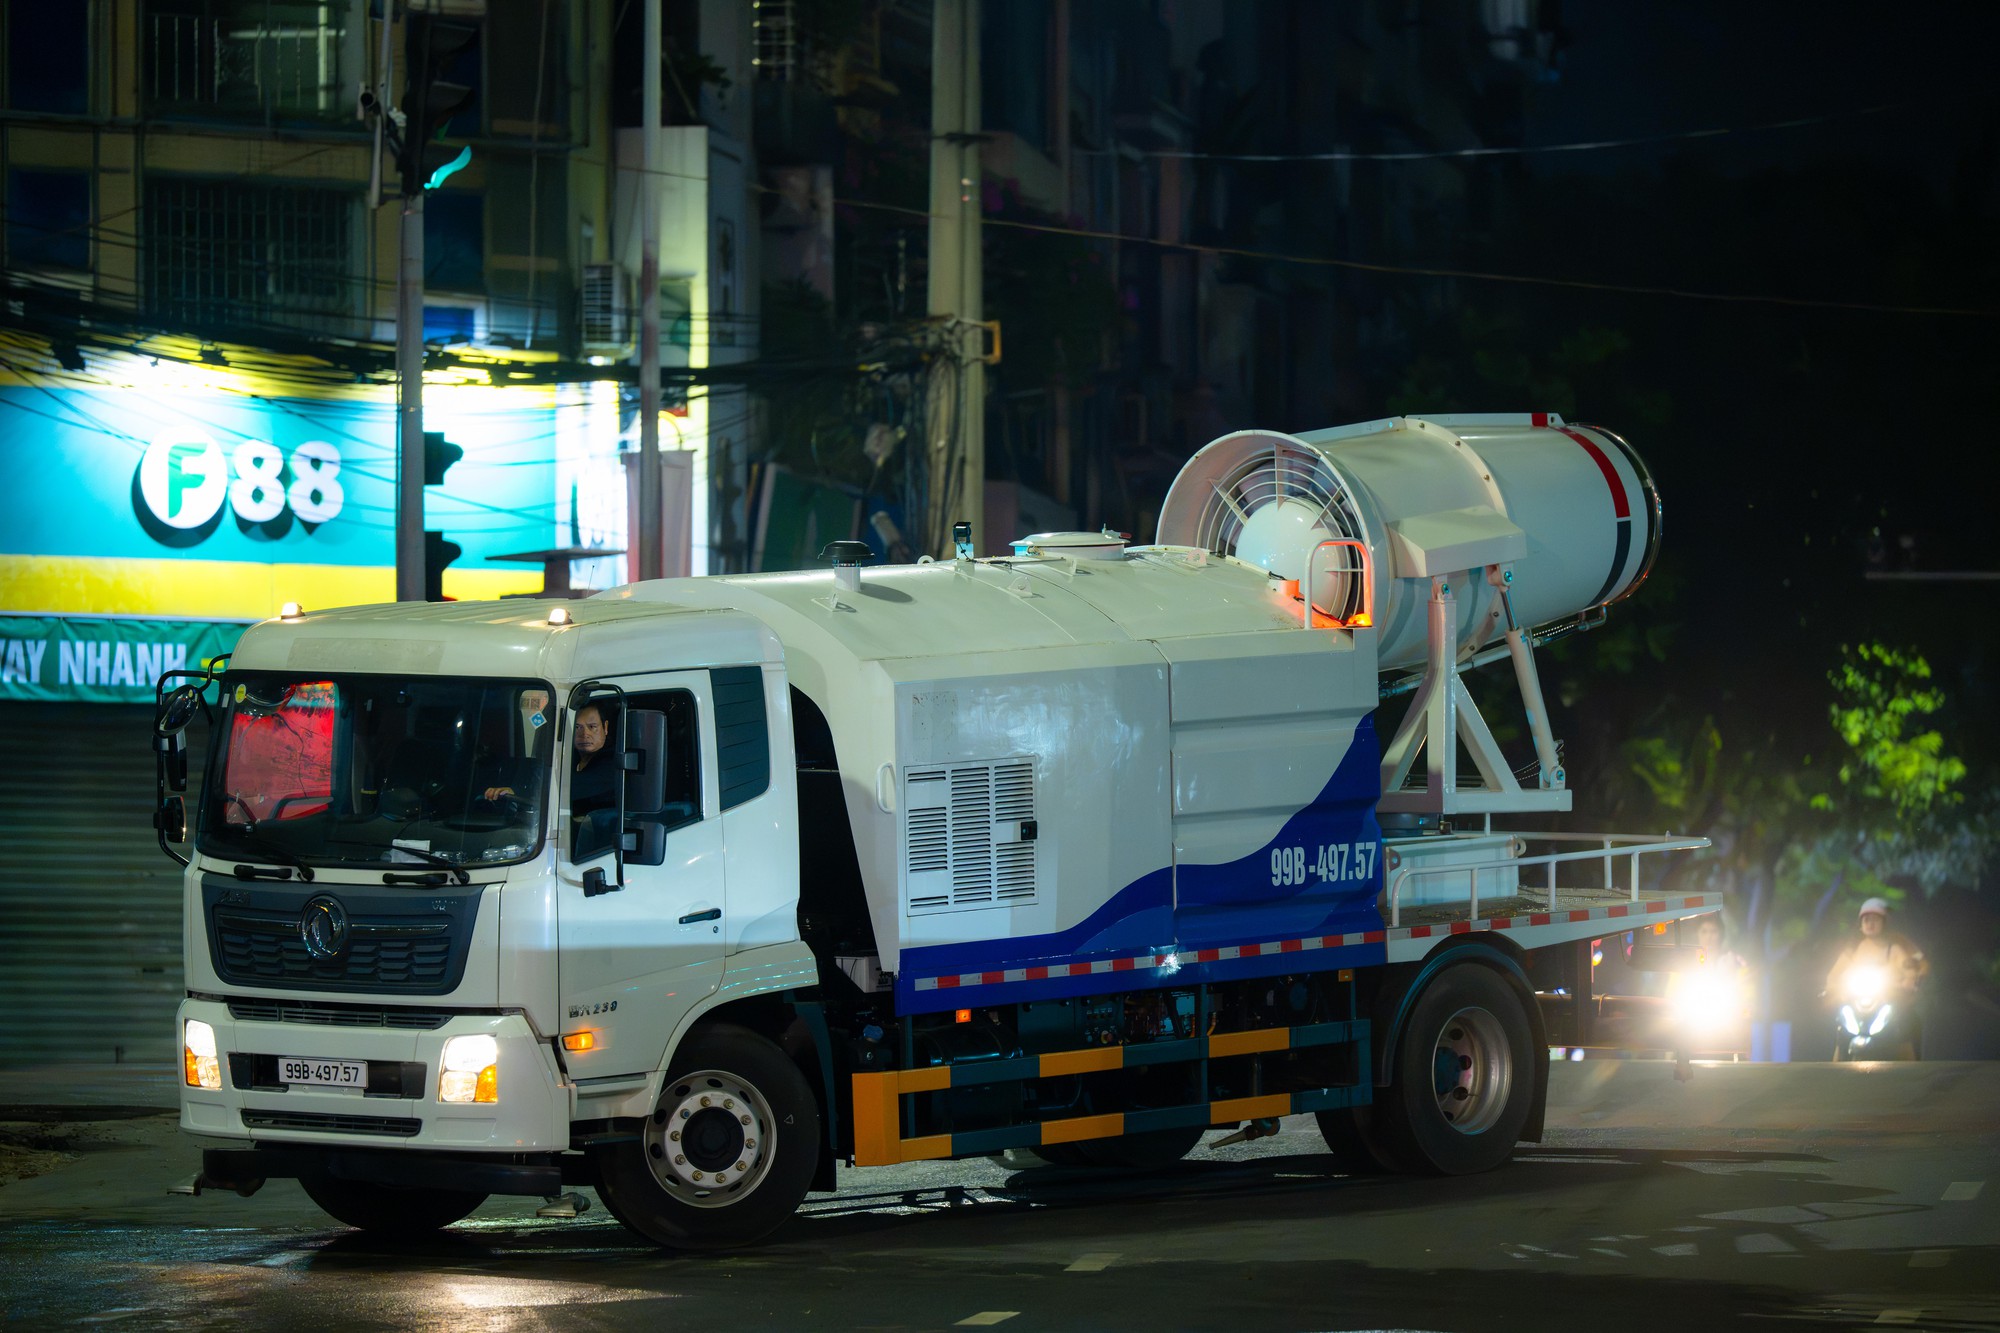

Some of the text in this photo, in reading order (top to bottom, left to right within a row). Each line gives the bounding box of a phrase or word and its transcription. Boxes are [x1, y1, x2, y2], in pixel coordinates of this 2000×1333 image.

[160, 436, 345, 525] F88
[0, 639, 47, 684] AY
[59, 639, 187, 687] NHANH
[1271, 841, 1377, 887] 99B-497.57
